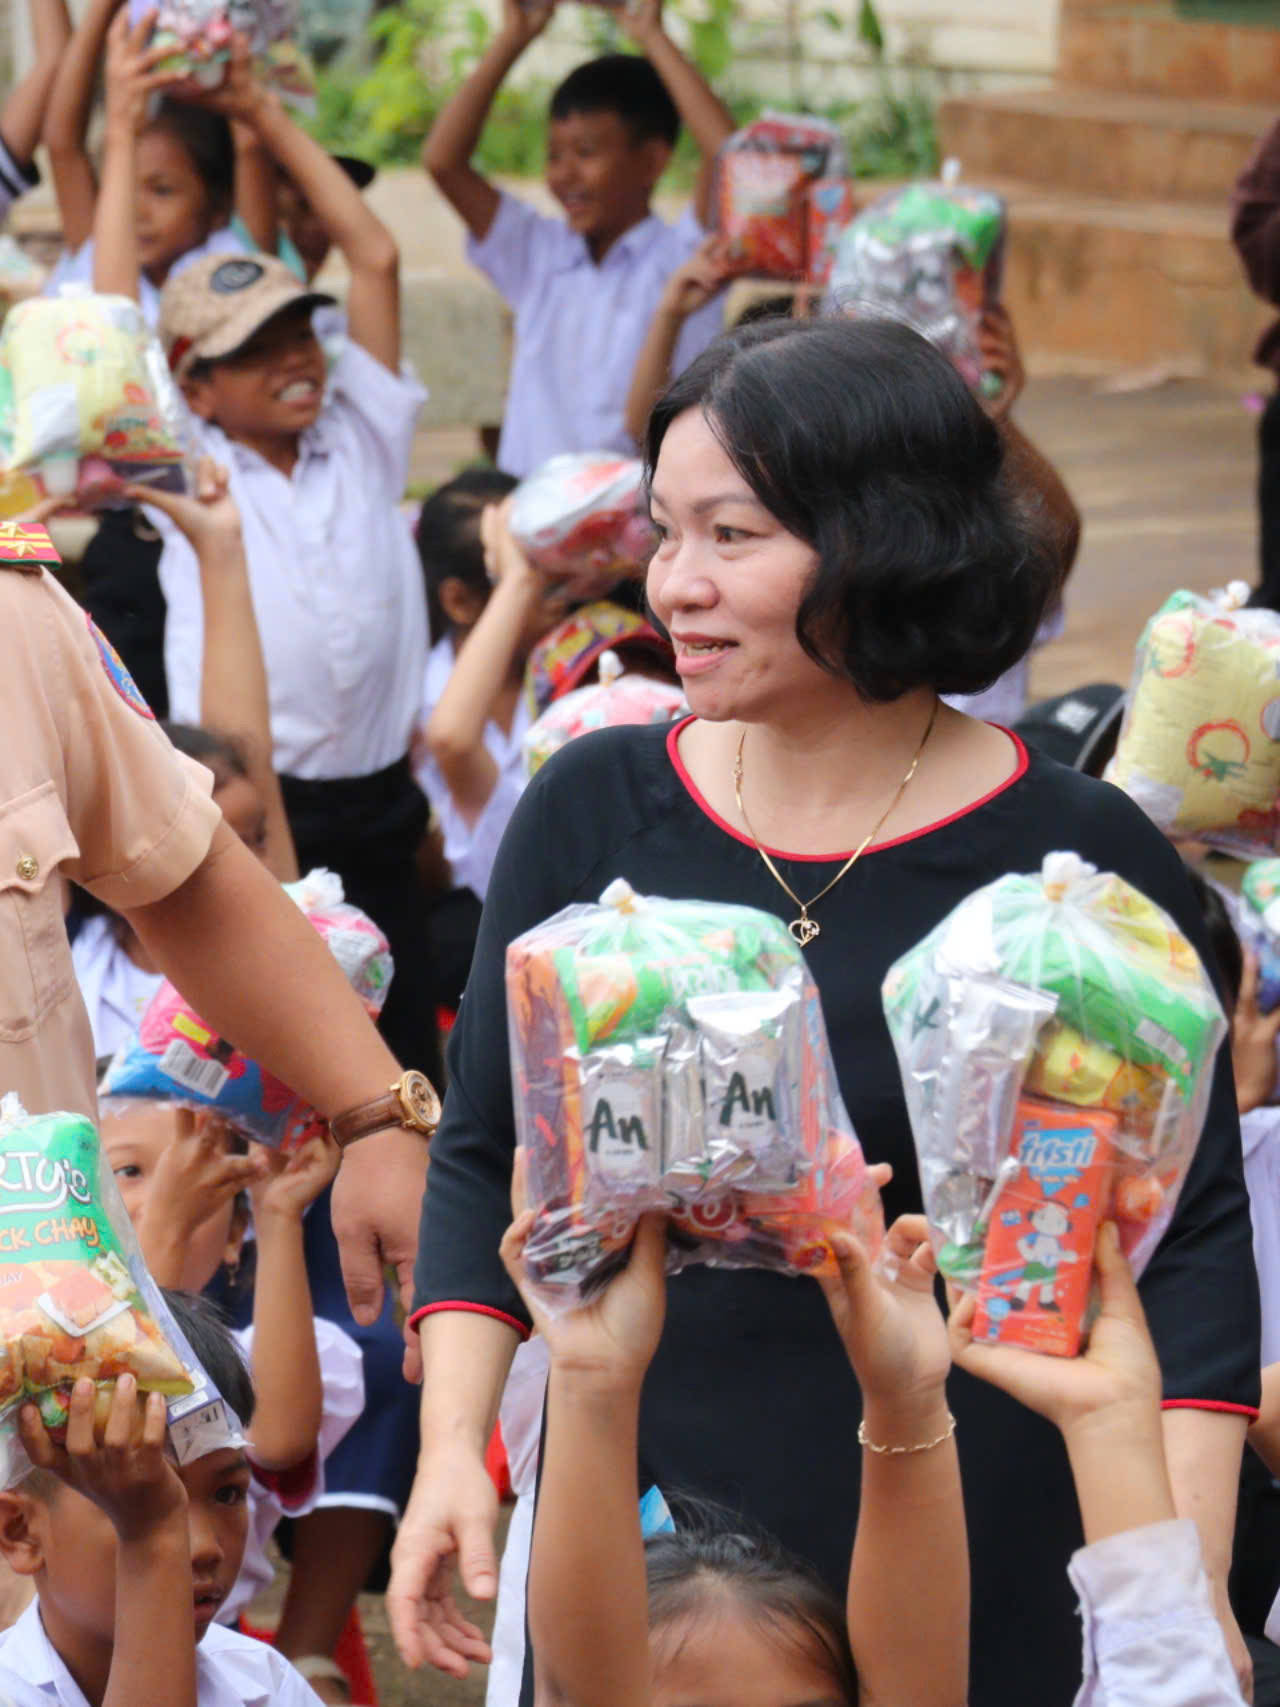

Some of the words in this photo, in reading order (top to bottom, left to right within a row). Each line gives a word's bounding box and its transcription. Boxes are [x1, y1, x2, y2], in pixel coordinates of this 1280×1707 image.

[720, 1071, 777, 1126] An
[583, 1098, 648, 1153] An
[1019, 1130, 1099, 1170] fristi
[33, 1215, 100, 1247] CHAY
